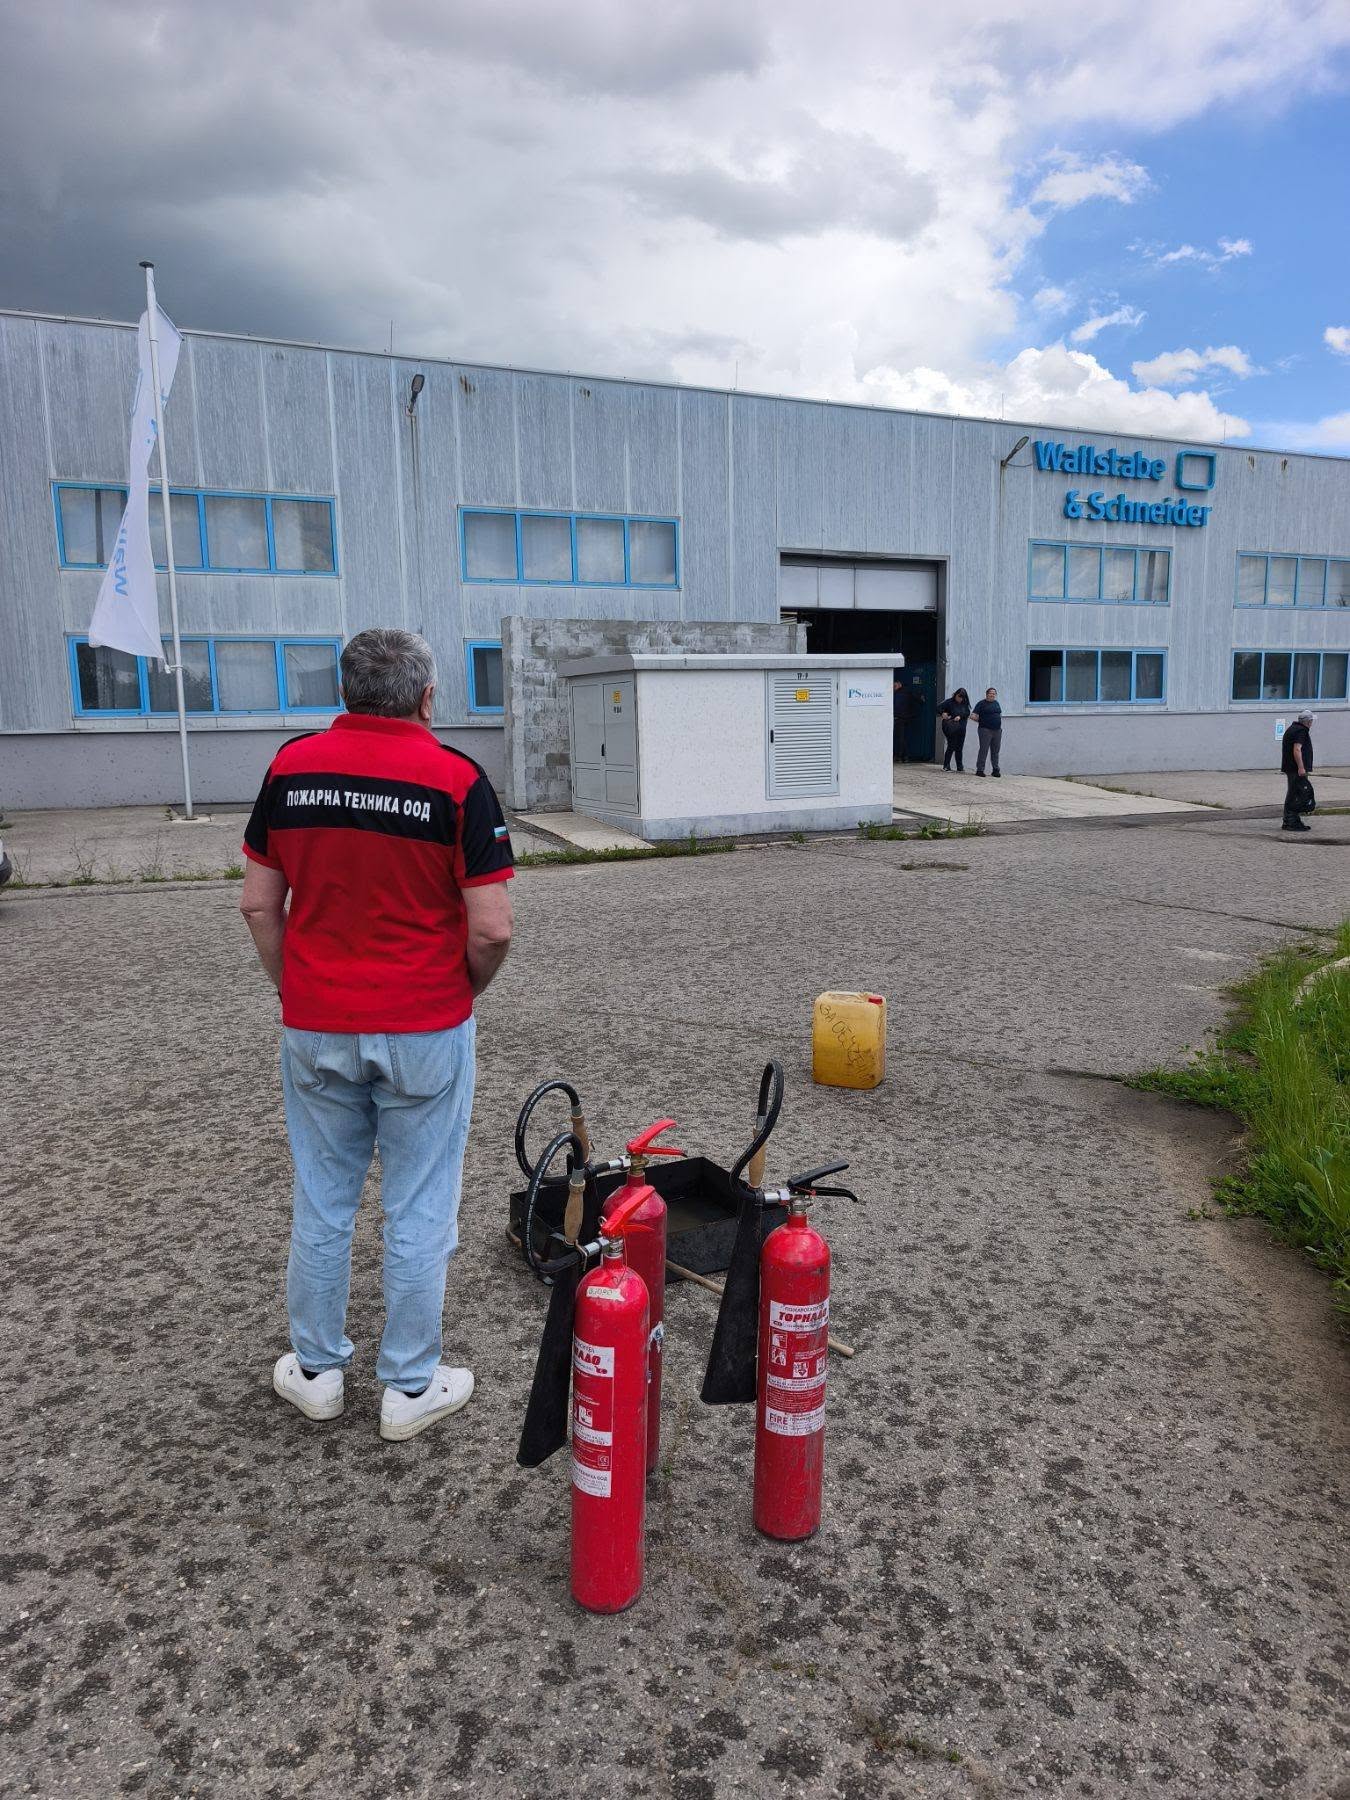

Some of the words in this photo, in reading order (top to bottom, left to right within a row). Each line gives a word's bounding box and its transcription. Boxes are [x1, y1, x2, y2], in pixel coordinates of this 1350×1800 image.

[1034, 440, 1166, 480] Wallstabe
[1064, 488, 1082, 518] &
[1087, 490, 1212, 527] Schneider
[286, 789, 341, 807] ПОЖАРНА
[343, 791, 400, 814] ТЕХНИКА
[403, 799, 431, 822] ООД
